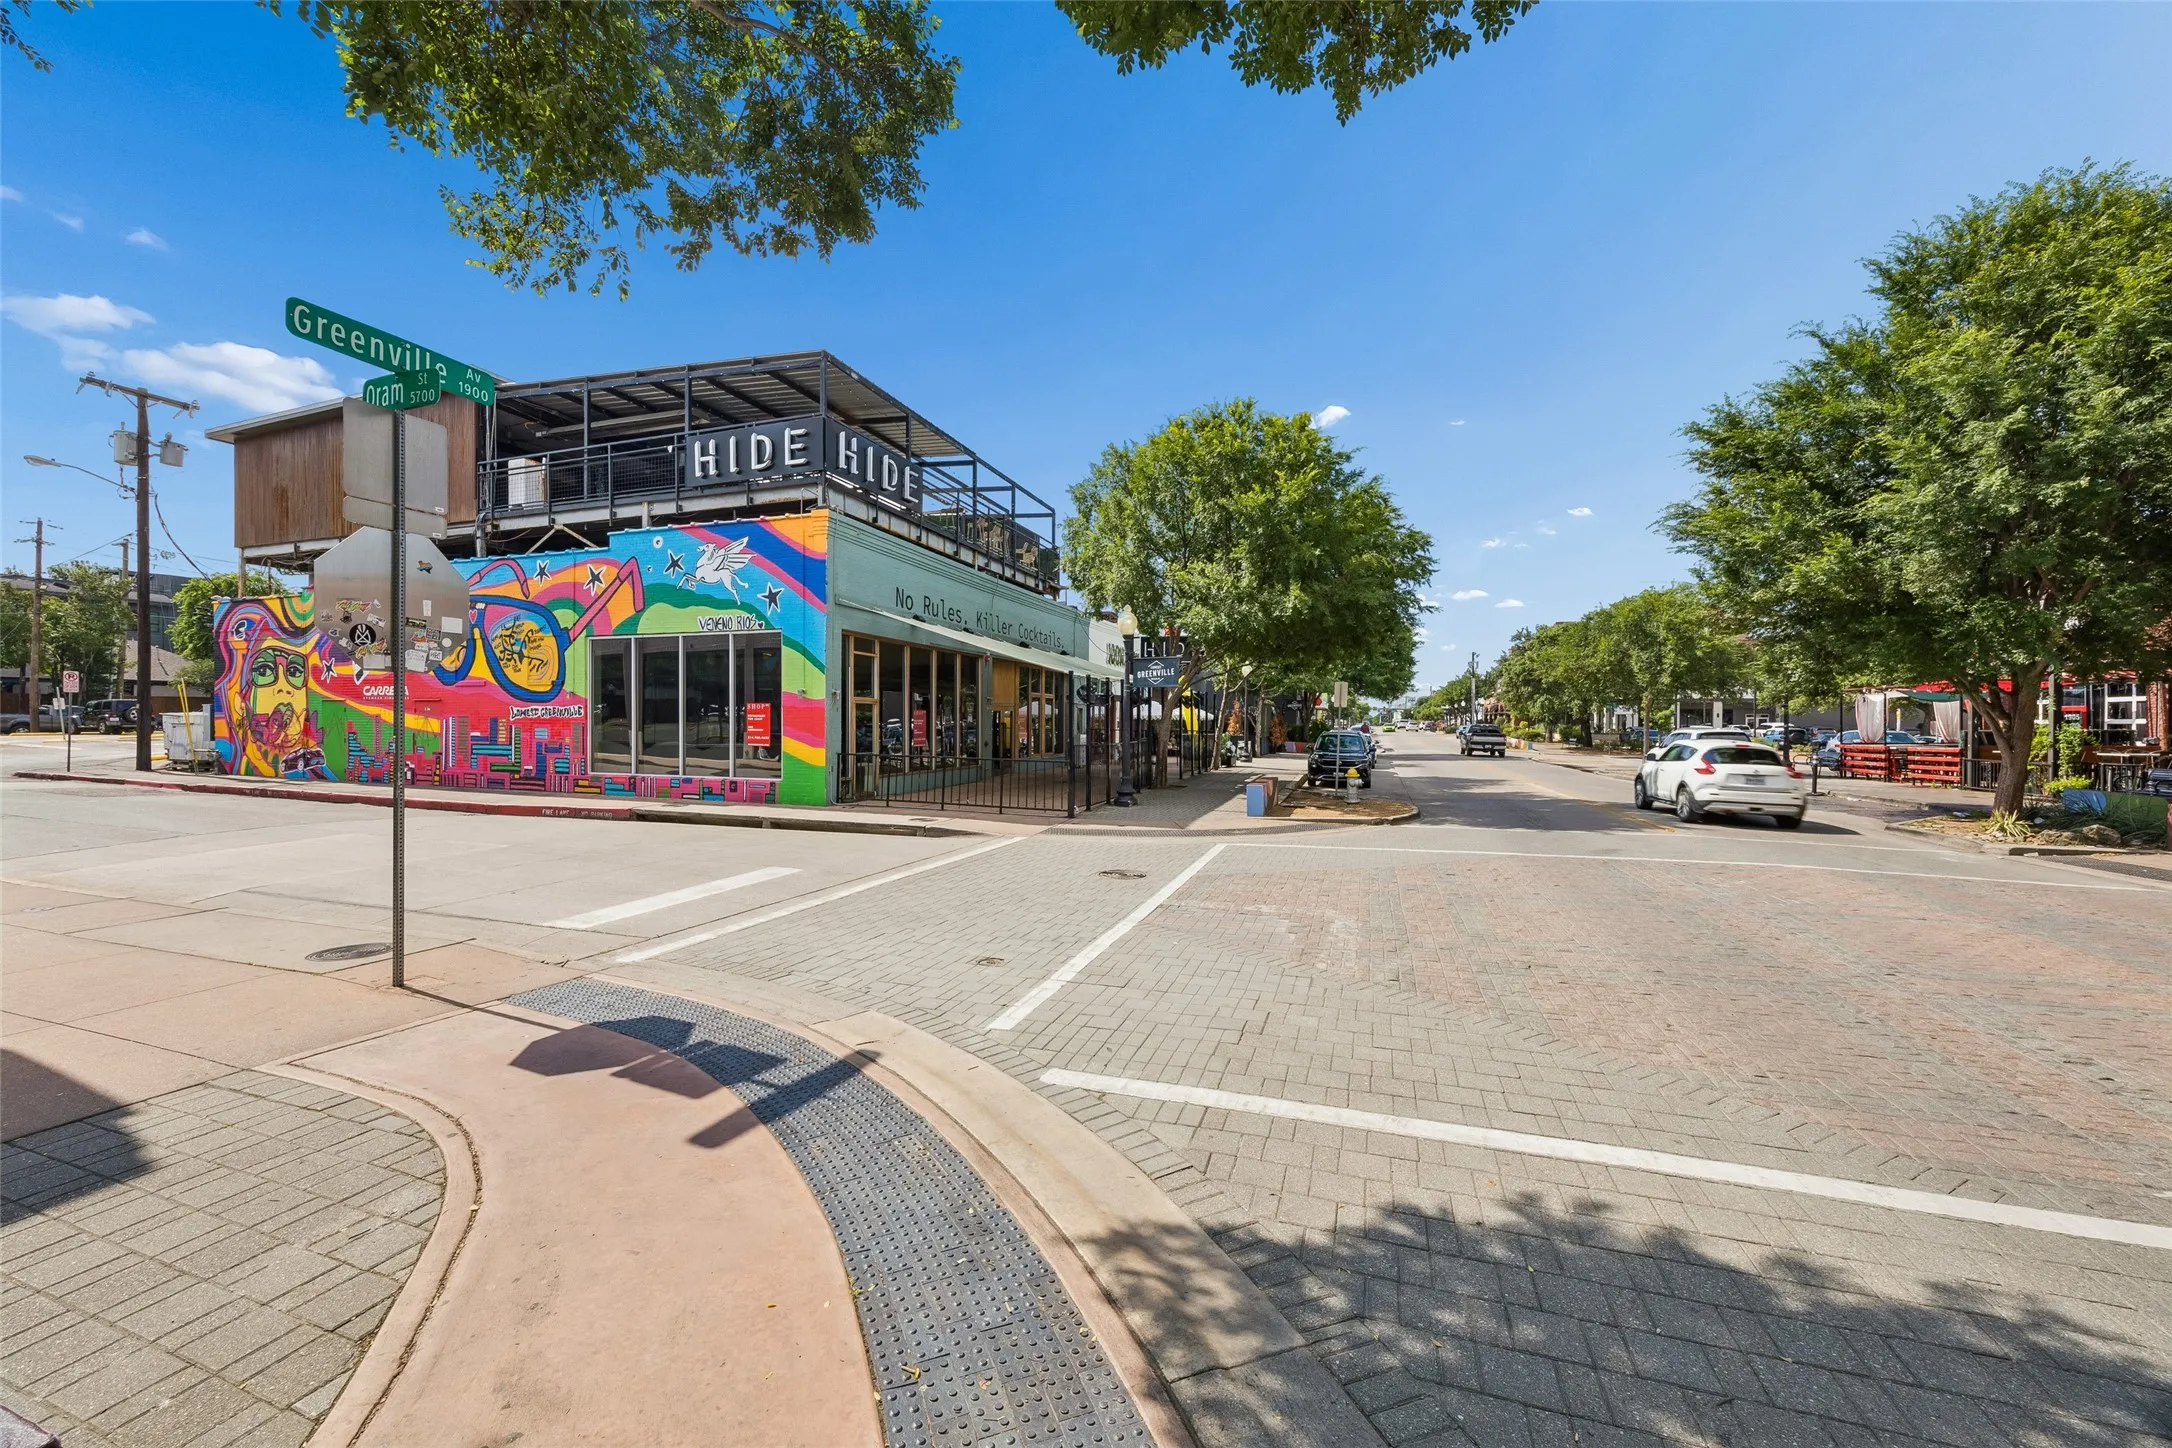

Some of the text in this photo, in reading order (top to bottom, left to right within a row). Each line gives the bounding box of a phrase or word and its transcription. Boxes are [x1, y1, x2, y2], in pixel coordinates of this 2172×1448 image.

[293, 305, 447, 384] Greenville
[418, 372, 428, 385] St
[466, 368, 481, 383] Av
[366, 383, 404, 406] Oram
[410, 389, 435, 403] 5700
[459, 382, 488, 402] 1900
[694, 427, 808, 478] HIDE
[839, 431, 919, 503] HIDE
[736, 615, 757, 630] RIOS
[895, 586, 1065, 649] No Rules. Killer Cocktails.
[1136, 667, 1175, 679] GREENVILLE
[363, 685, 409, 696] CARREA
[510, 705, 583, 719] LOWEST GREENVILLE
